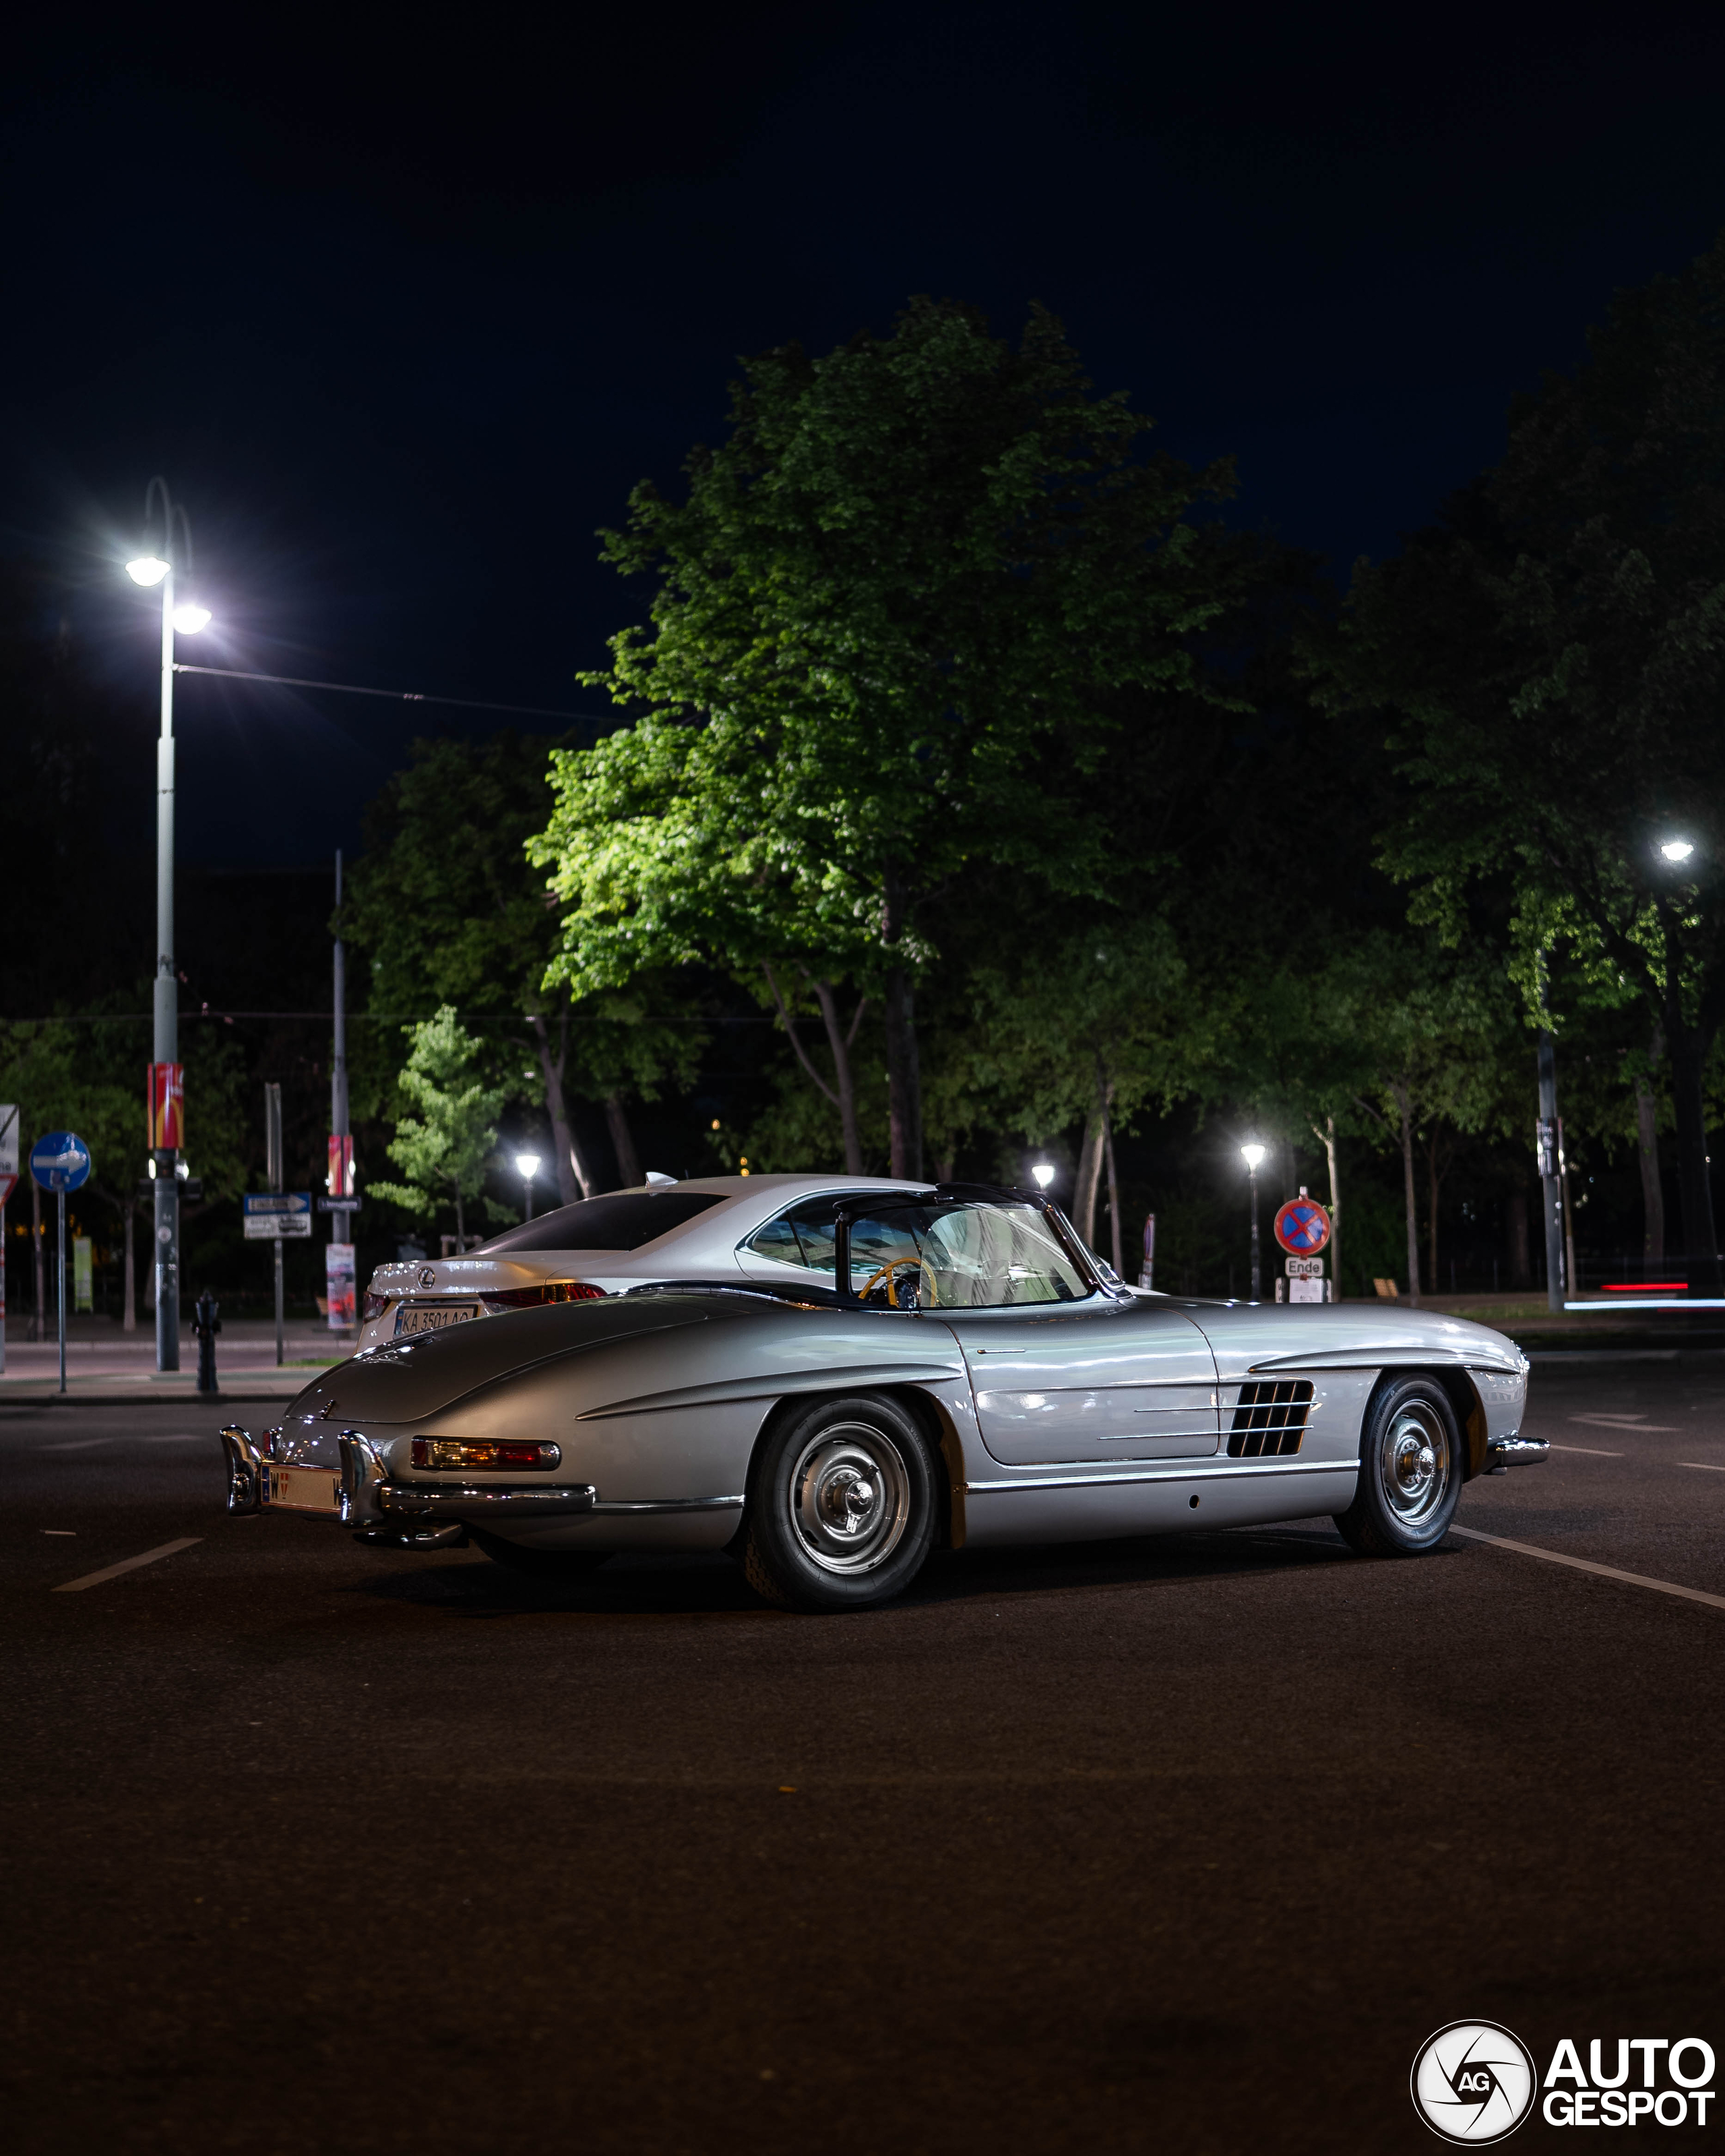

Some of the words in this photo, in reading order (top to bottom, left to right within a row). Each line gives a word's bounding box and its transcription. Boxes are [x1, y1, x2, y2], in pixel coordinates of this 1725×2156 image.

[1288, 1261, 1319, 1273] Ende
[402, 1312, 418, 1332] KA
[421, 1312, 448, 1331] 3501
[270, 1471, 279, 1499] W
